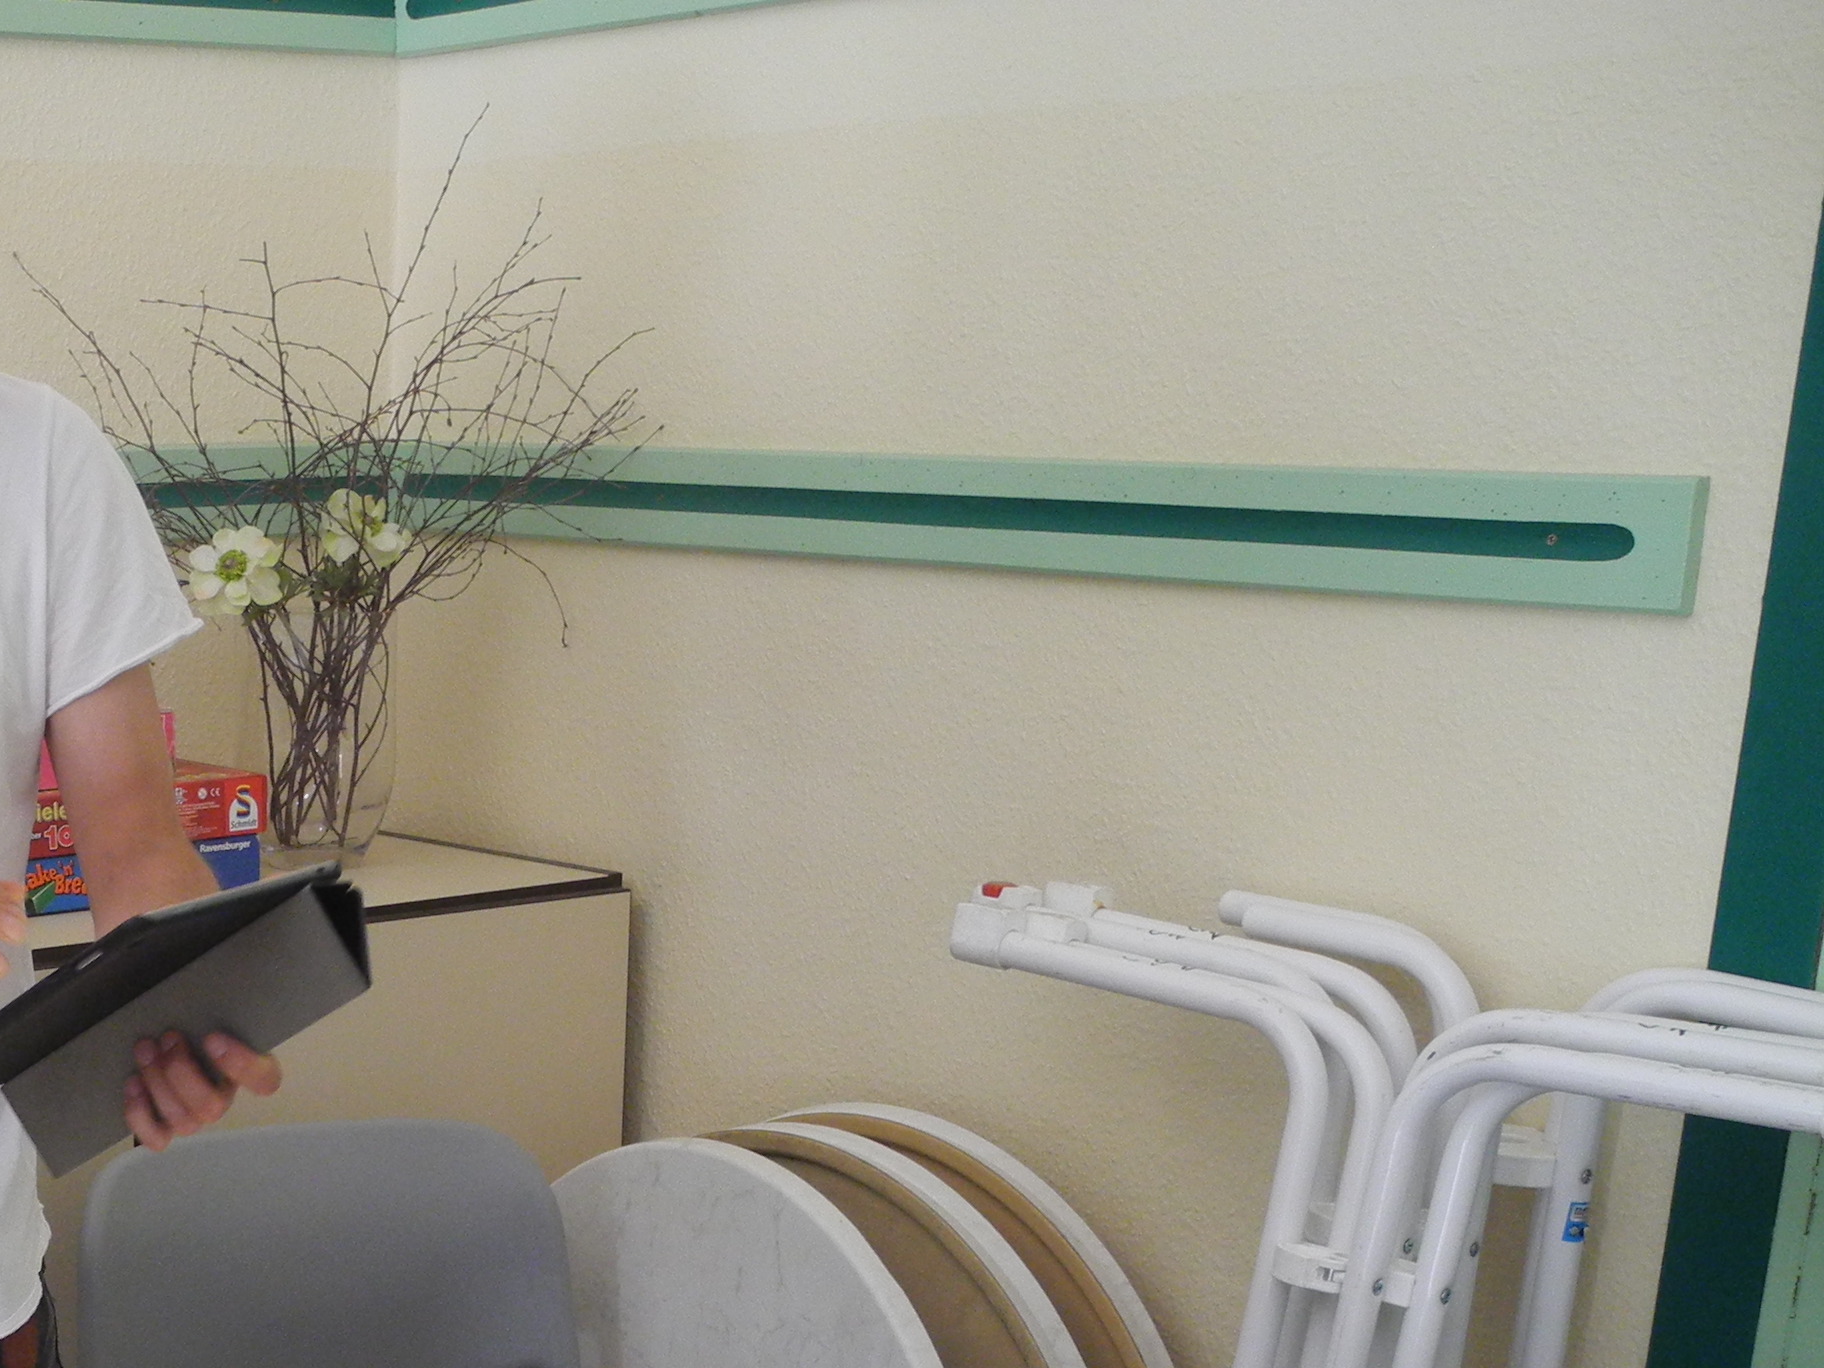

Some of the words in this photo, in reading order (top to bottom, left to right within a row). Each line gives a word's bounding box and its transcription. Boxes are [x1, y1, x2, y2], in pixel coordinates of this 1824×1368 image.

[231, 819, 257, 829] Schmidt
[199, 841, 251, 853] Ravensburger
[26, 864, 57, 891] ake
